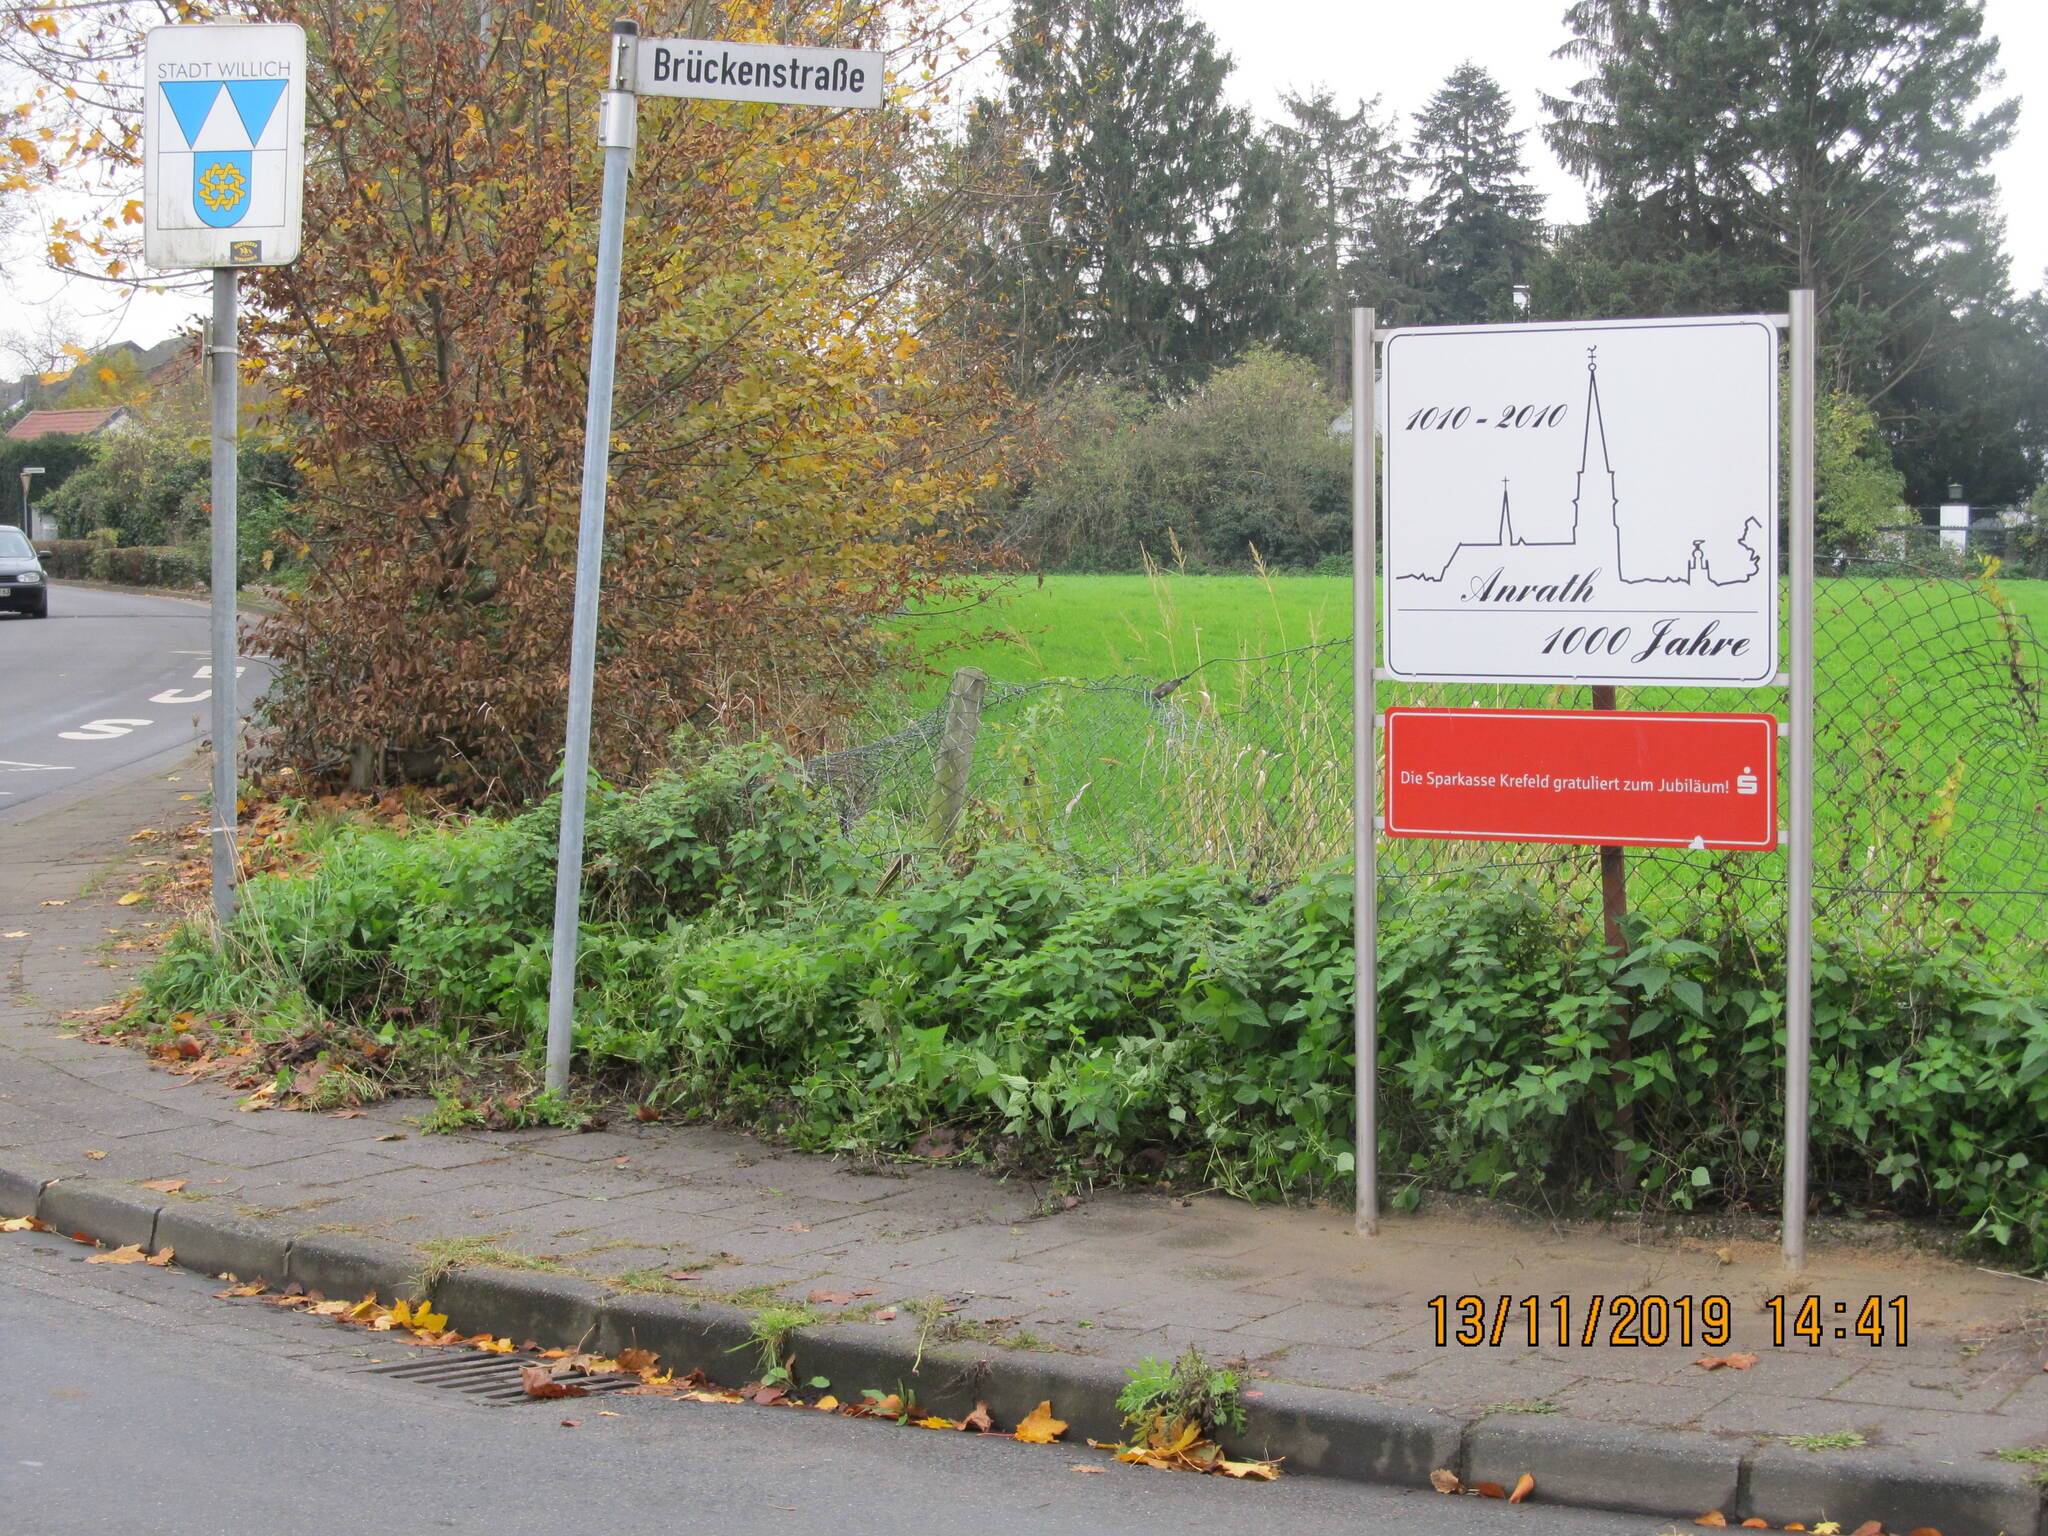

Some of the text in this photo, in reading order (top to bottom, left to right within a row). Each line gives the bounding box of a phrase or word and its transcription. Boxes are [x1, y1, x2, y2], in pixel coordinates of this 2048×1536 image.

[158, 60, 291, 79] STADT WILLICH
[653, 47, 866, 93] Brückenstraße
[1405, 406, 1472, 431] 1010
[1494, 403, 1568, 429] 2010
[1460, 566, 1603, 604] Anrath
[1540, 617, 1751, 664] 1000 Jahre
[1400, 770, 1423, 786] Die
[1426, 771, 1496, 788] Sparkasse
[1500, 773, 1549, 789] Krefeld
[1553, 775, 1621, 792] gratuliert
[1623, 780, 1654, 792] zum
[1657, 778, 1730, 794] Jubiläum!
